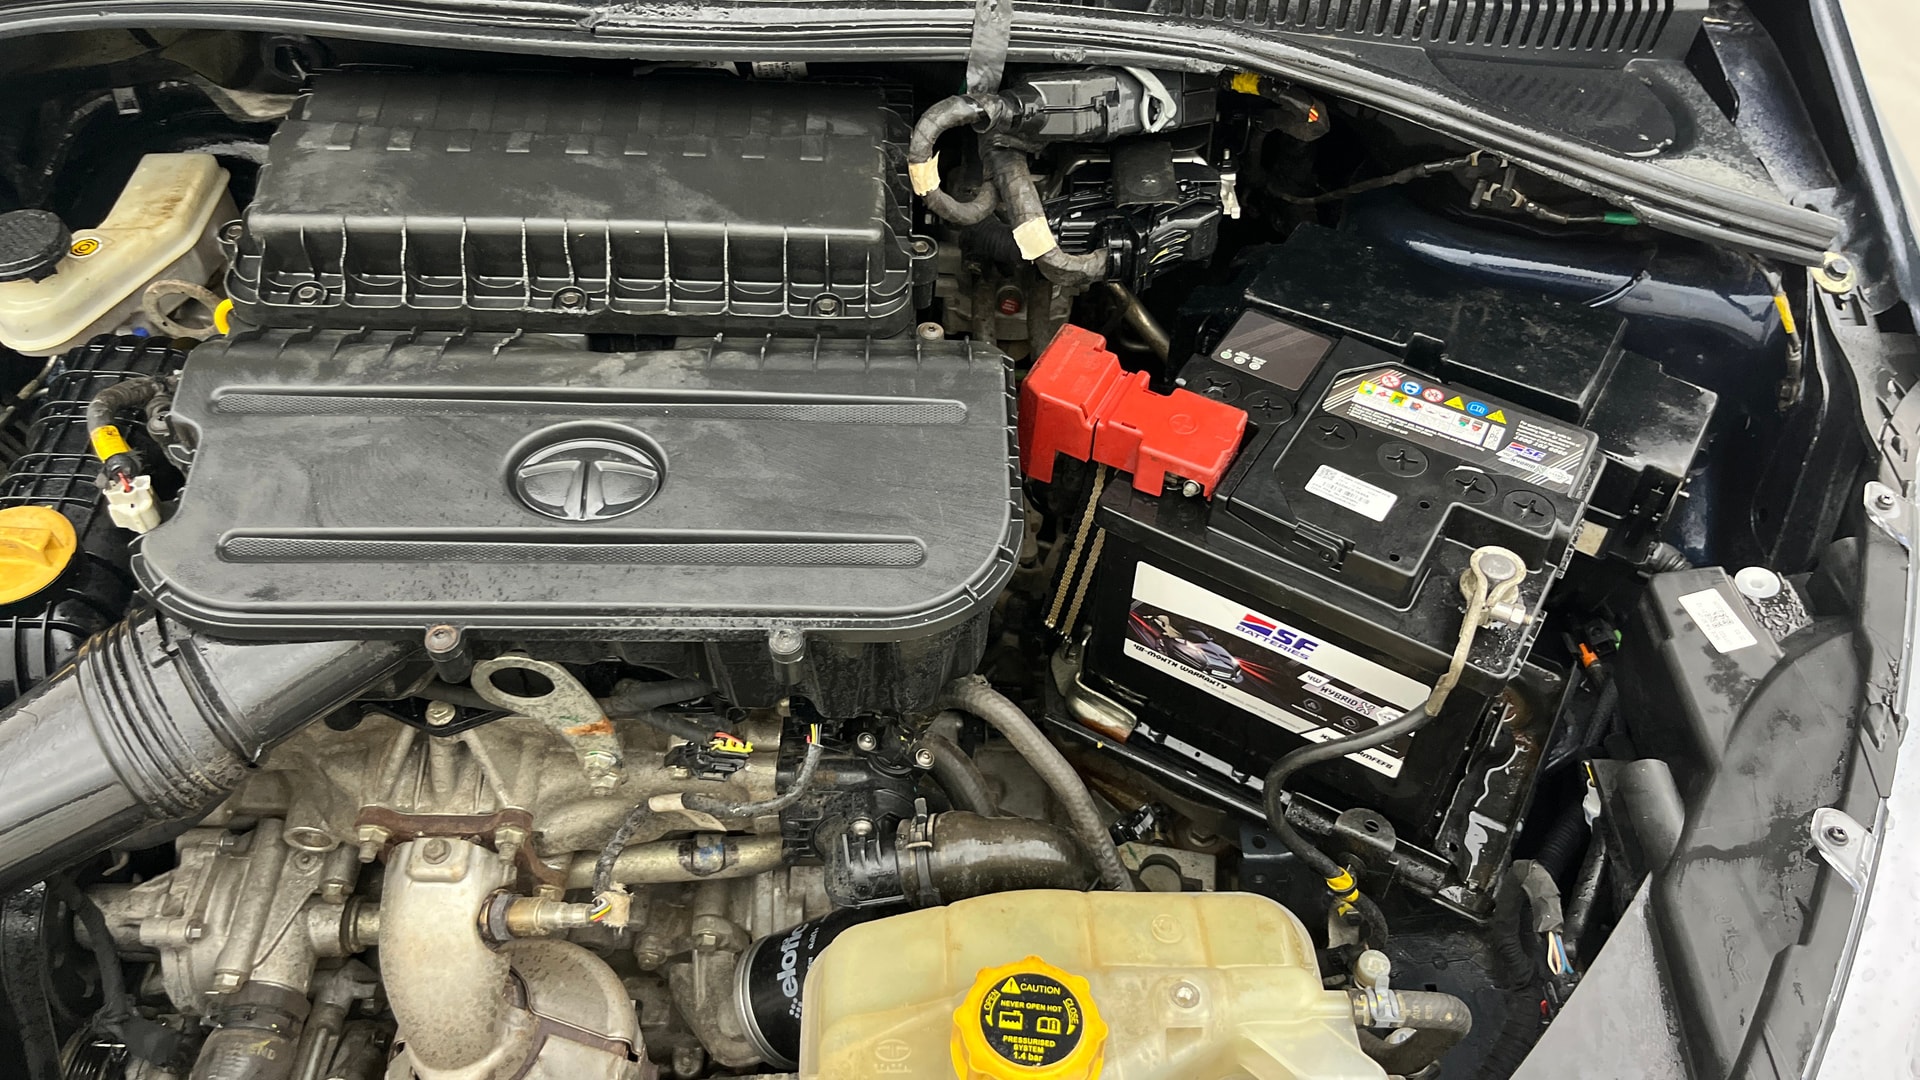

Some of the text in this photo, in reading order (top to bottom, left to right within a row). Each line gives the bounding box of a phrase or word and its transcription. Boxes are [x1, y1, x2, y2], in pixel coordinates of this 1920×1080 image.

[1235, 625, 1310, 660] BATTERIES
[1272, 629, 1319, 652] SF
[1180, 665, 1228, 690] WARRANTY
[1320, 686, 1359, 706] HYBRID
[776, 923, 809, 998] elofic
[984, 988, 1000, 1011] OPEN
[1020, 983, 1060, 995] CAUTION
[1000, 999, 1062, 1013] NEVER OPEN HOT
[1064, 997, 1079, 1025] CLOSE
[1002, 1035, 1056, 1047] PRESSURISED
[1013, 1044, 1044, 1053] SYSTEM
[1013, 1051, 1043, 1061] 1.4 bar
